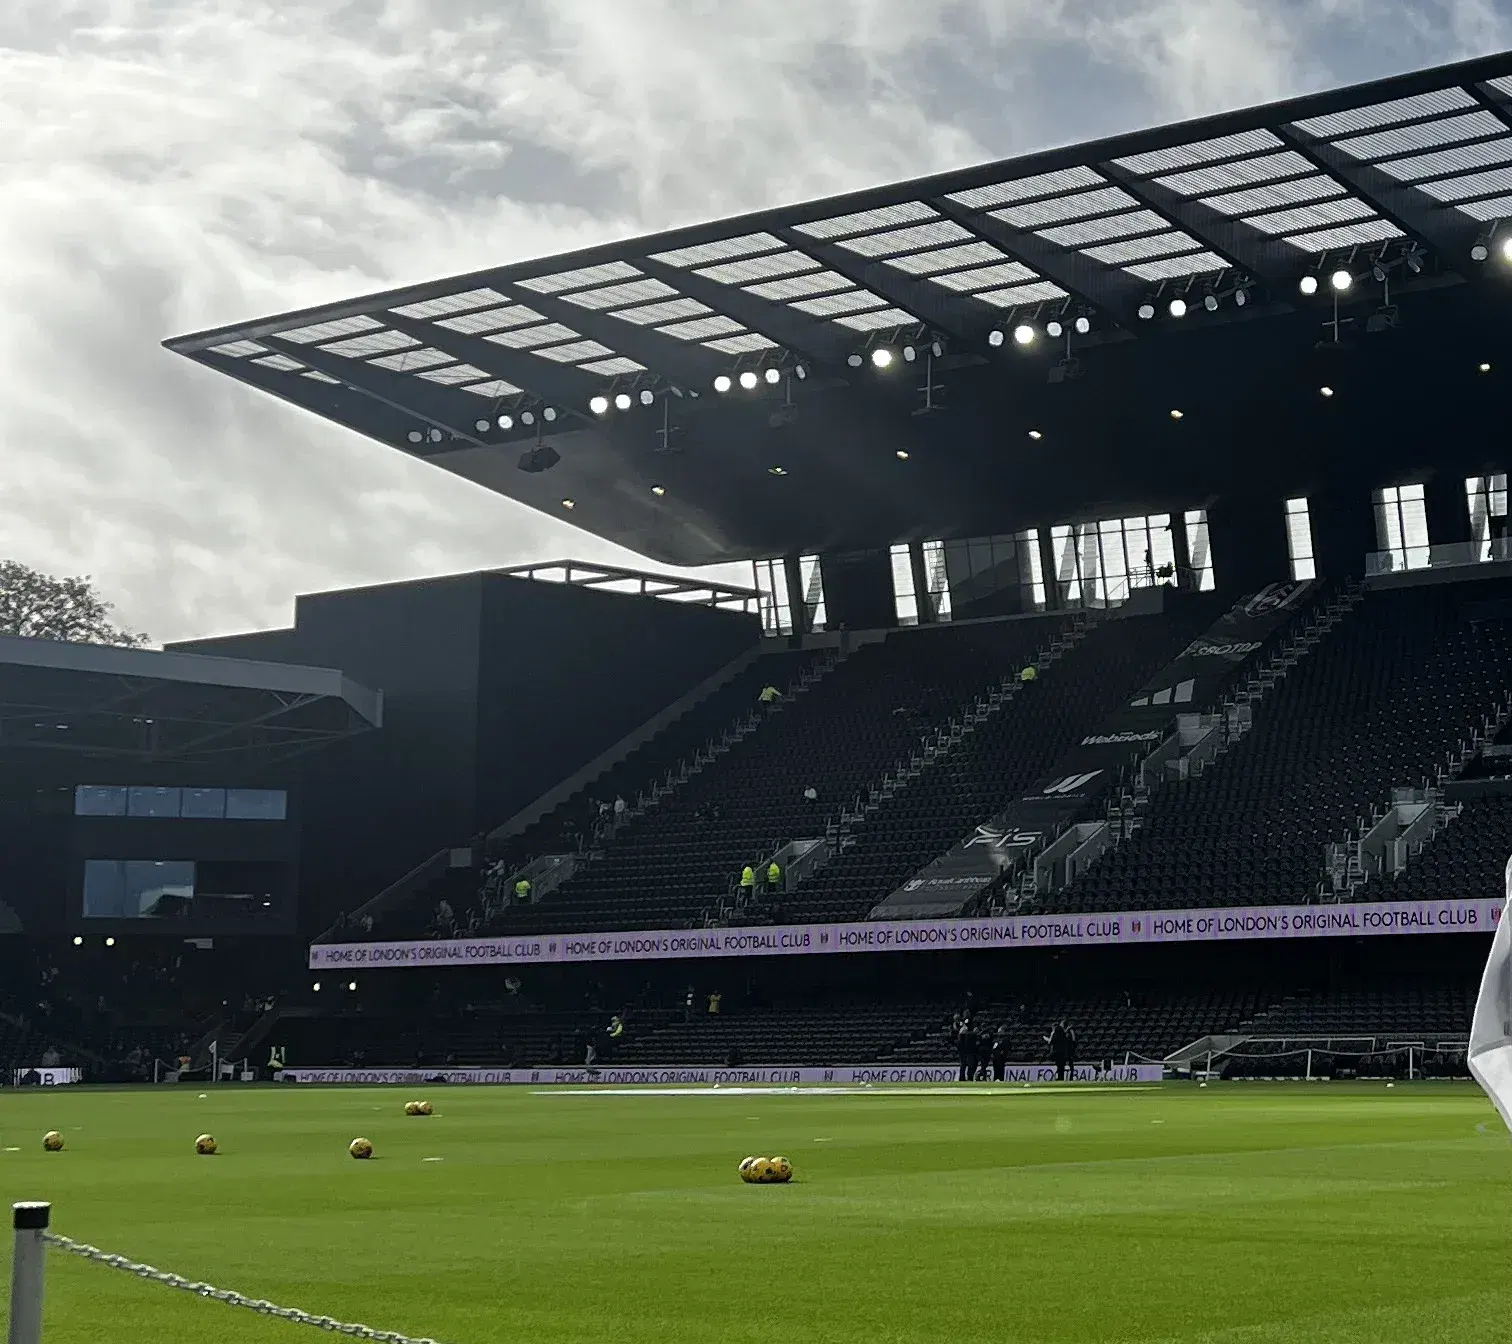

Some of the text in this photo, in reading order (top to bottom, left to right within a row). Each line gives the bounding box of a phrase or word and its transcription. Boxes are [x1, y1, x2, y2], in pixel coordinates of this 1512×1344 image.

[1153, 909, 1477, 934] HOME OF LONDON'S ORIGINAL FOOTBALL CLUB
[839, 922, 1120, 945] HOME OF LONDON'S ORIGINAL FOOTBALL CLUB
[325, 950, 352, 962] HOME
[355, 949, 367, 962] OF
[418, 946, 463, 960] ORIGINAL
[465, 944, 513, 959] FOOTBALL
[514, 943, 541, 957] CLUB
[565, 934, 811, 954] HOME OF LONDON'S ORIGINAL FOOTBALL CLUB
[555, 1071, 586, 1083] HOME
[604, 1071, 657, 1083] LONDON'S
[660, 1071, 710, 1083] ORIGINAL
[714, 1071, 769, 1083] FOOTBALL
[771, 1070, 800, 1083] CLUB
[852, 1069, 888, 1082] HOME
[890, 1069, 907, 1082] OF
